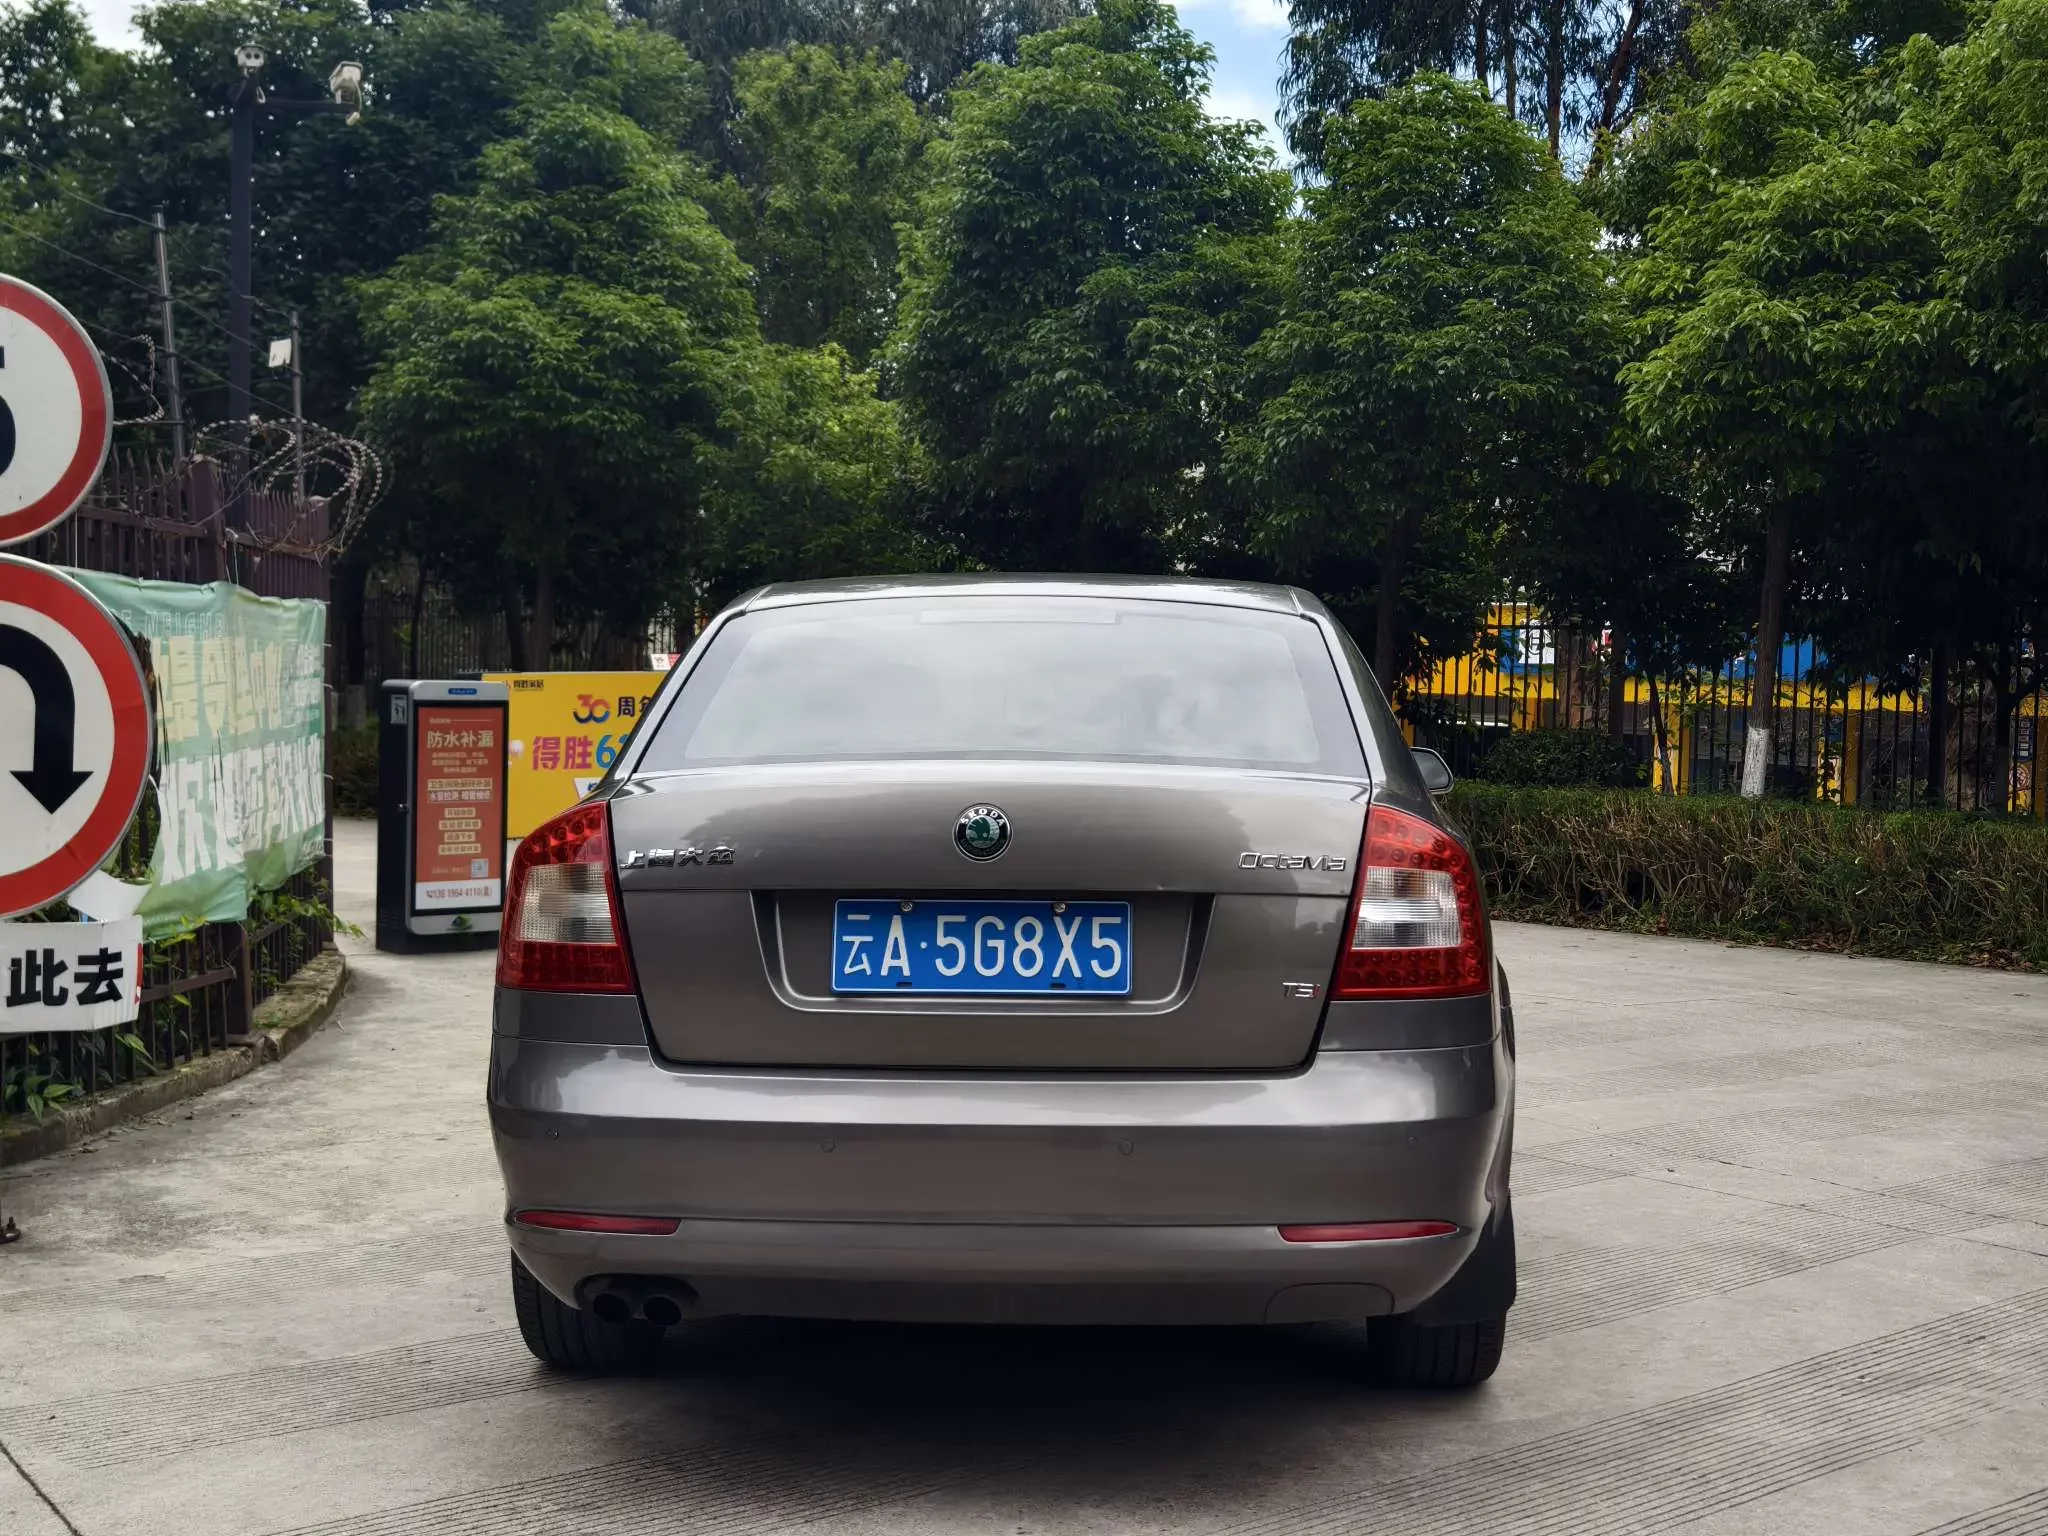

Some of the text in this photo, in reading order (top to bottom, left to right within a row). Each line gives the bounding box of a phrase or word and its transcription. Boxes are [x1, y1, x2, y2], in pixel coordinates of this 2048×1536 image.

[427, 730, 494, 748] 防水补漏
[532, 734, 630, 771] 得胜6
[960, 808, 1005, 827] SKODA
[619, 846, 736, 869] 上海大众
[1239, 852, 1346, 871] Octavia
[841, 914, 1123, 978] 云A·5G8X5
[6, 947, 124, 1007] 此去
